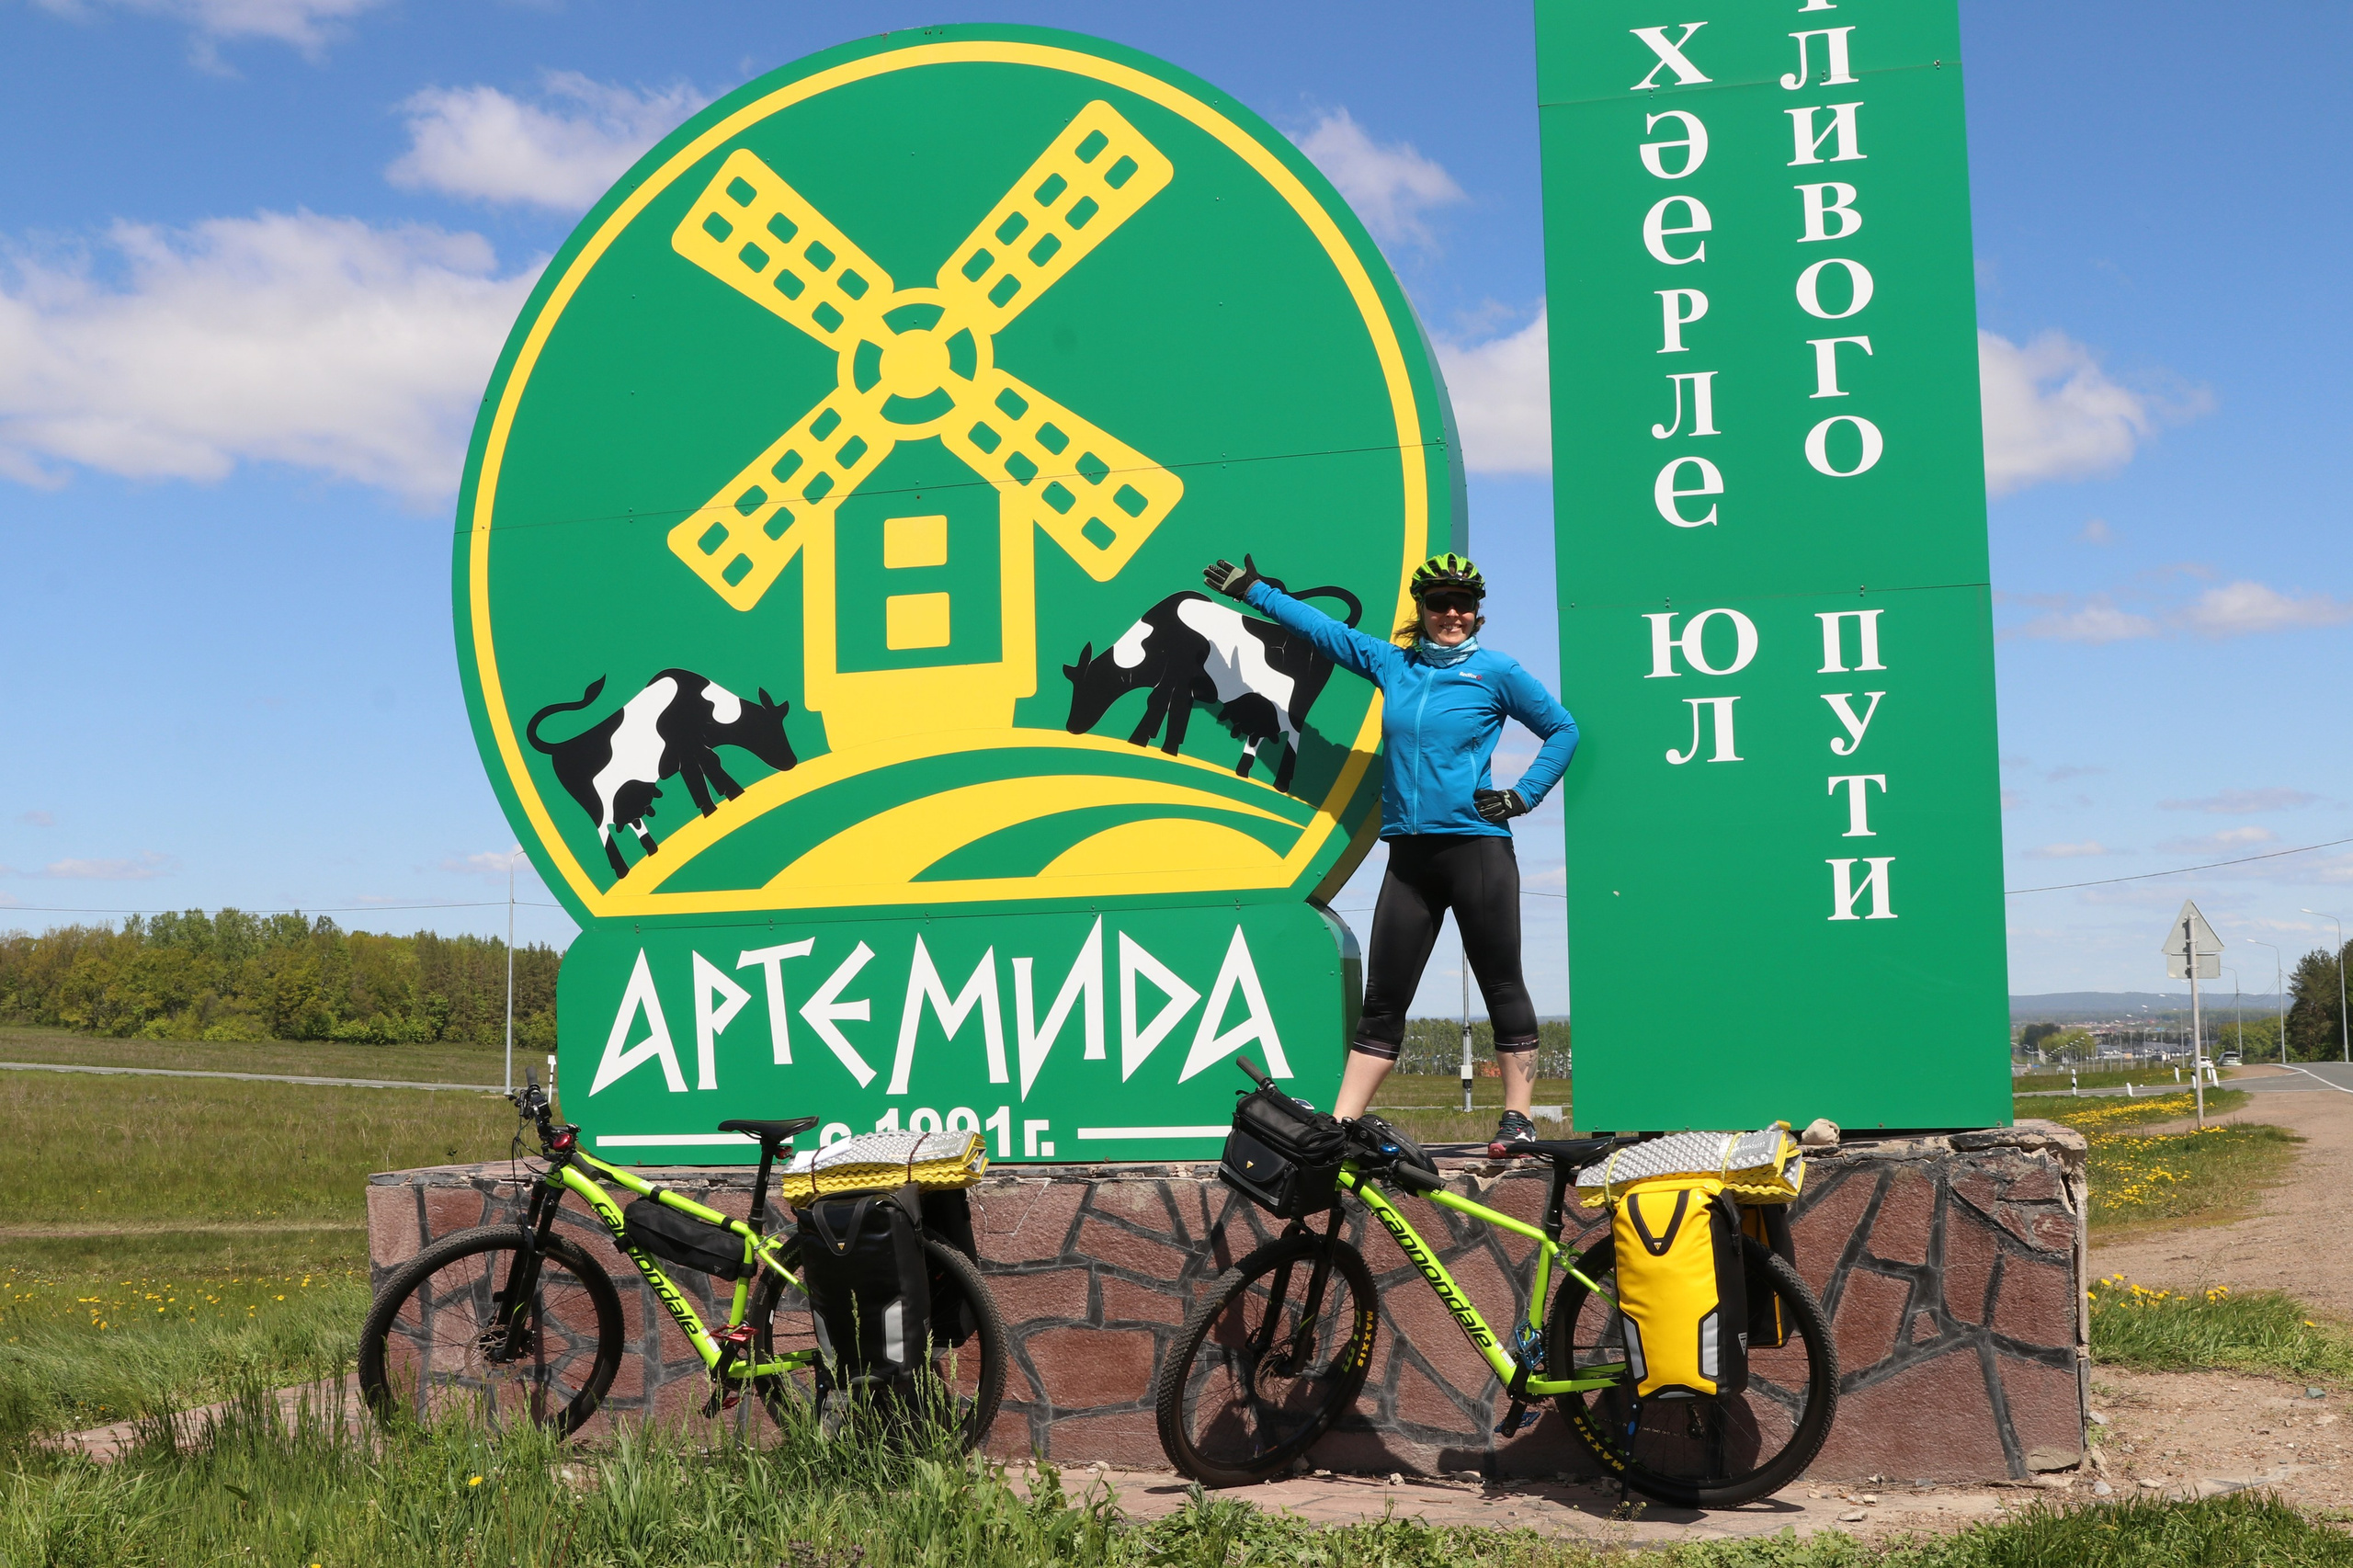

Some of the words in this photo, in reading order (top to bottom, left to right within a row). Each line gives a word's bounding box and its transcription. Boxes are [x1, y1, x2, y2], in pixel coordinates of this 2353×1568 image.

[588, 913, 1296, 1103] АРТЕМИДА
[594, 1202, 699, 1335] caondale
[1375, 1206, 1493, 1348] cannondale
[1357, 1311, 1374, 1368] MAXXIS
[1573, 1415, 1625, 1471] MAXXIS
